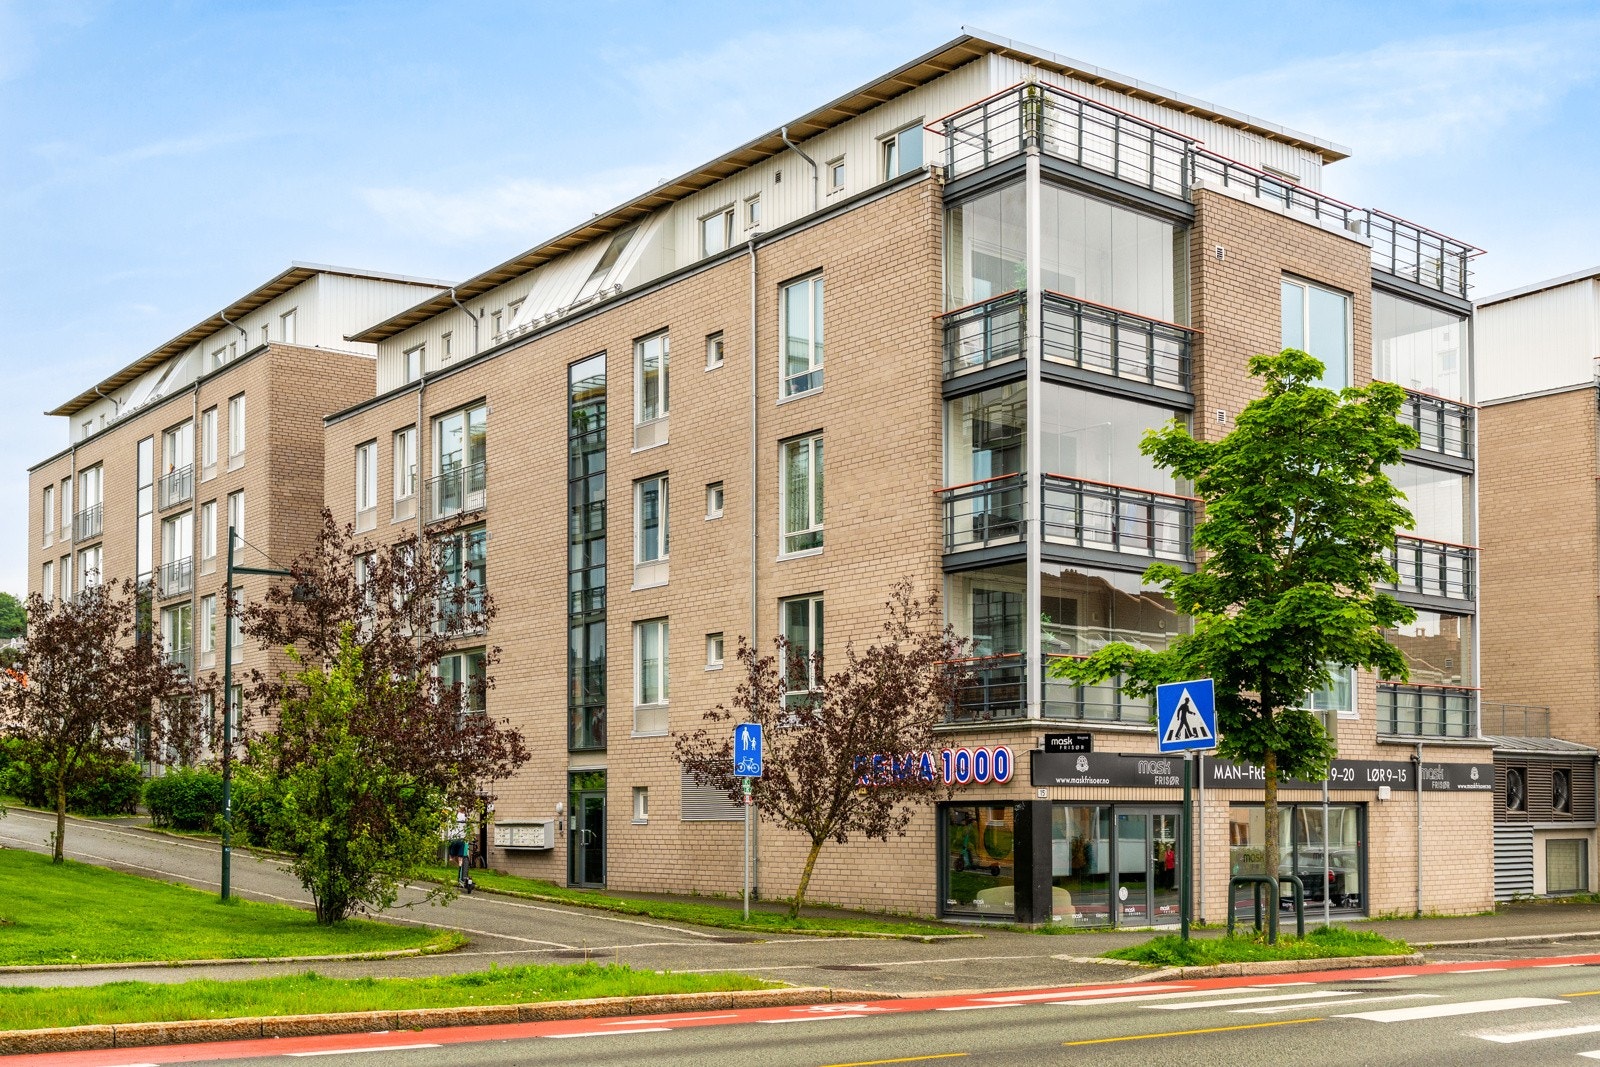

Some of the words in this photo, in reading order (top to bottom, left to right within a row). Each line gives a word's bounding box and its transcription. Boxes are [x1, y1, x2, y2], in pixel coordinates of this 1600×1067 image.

[1051, 736, 1073, 745] mask
[941, 746, 1014, 786] 1000
[1138, 758, 1171, 774] mask
[1055, 775, 1110, 785] www.maskfrisoer.no
[1154, 775, 1180, 786] FRISØR
[1367, 768, 1386, 782] LØR
